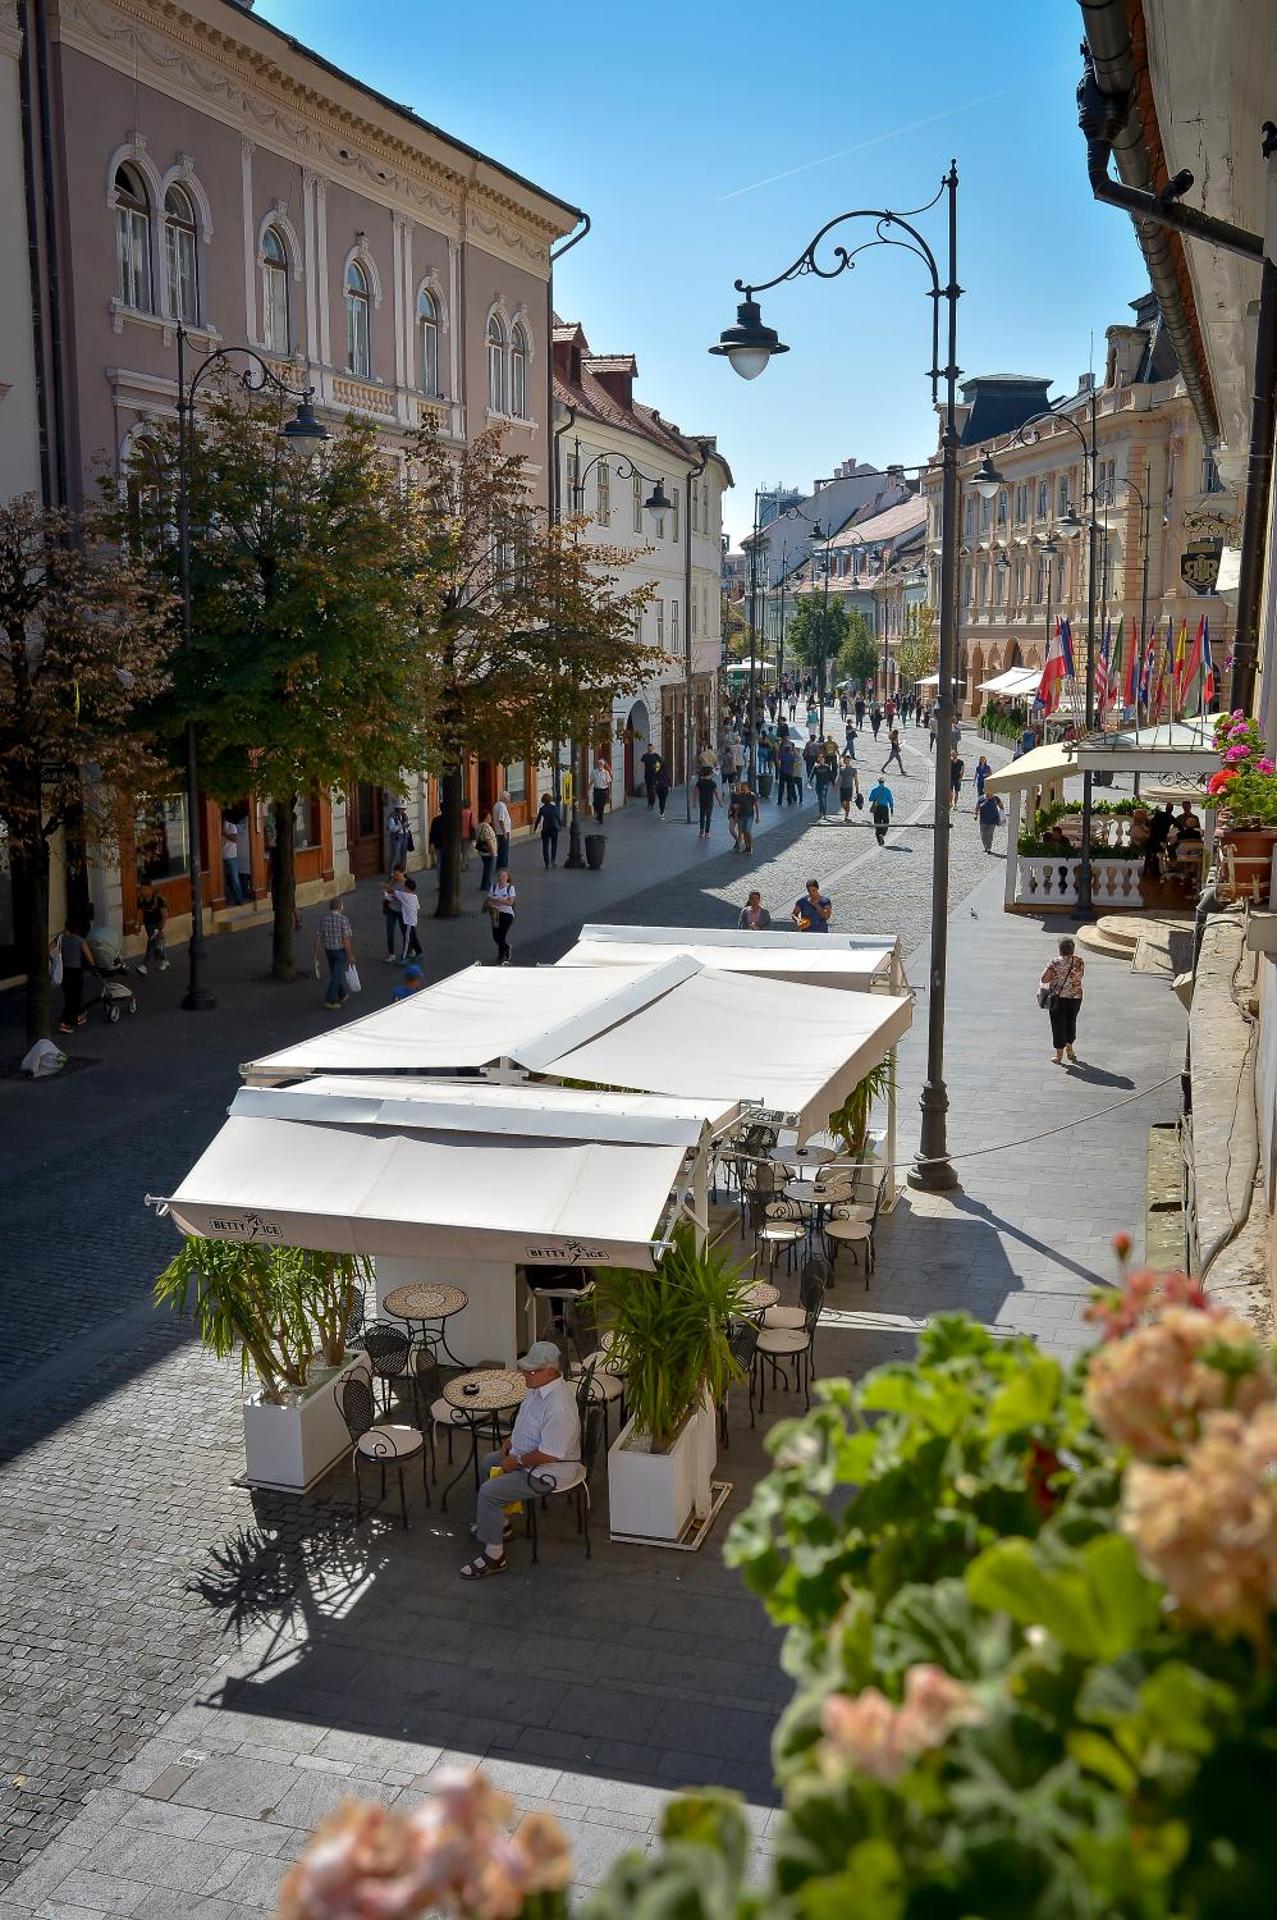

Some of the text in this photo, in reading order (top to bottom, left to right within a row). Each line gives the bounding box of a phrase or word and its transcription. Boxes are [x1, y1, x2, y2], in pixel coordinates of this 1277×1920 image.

[214, 1220, 280, 1235] BETTY ICE
[530, 1249, 566, 1258] BETTY
